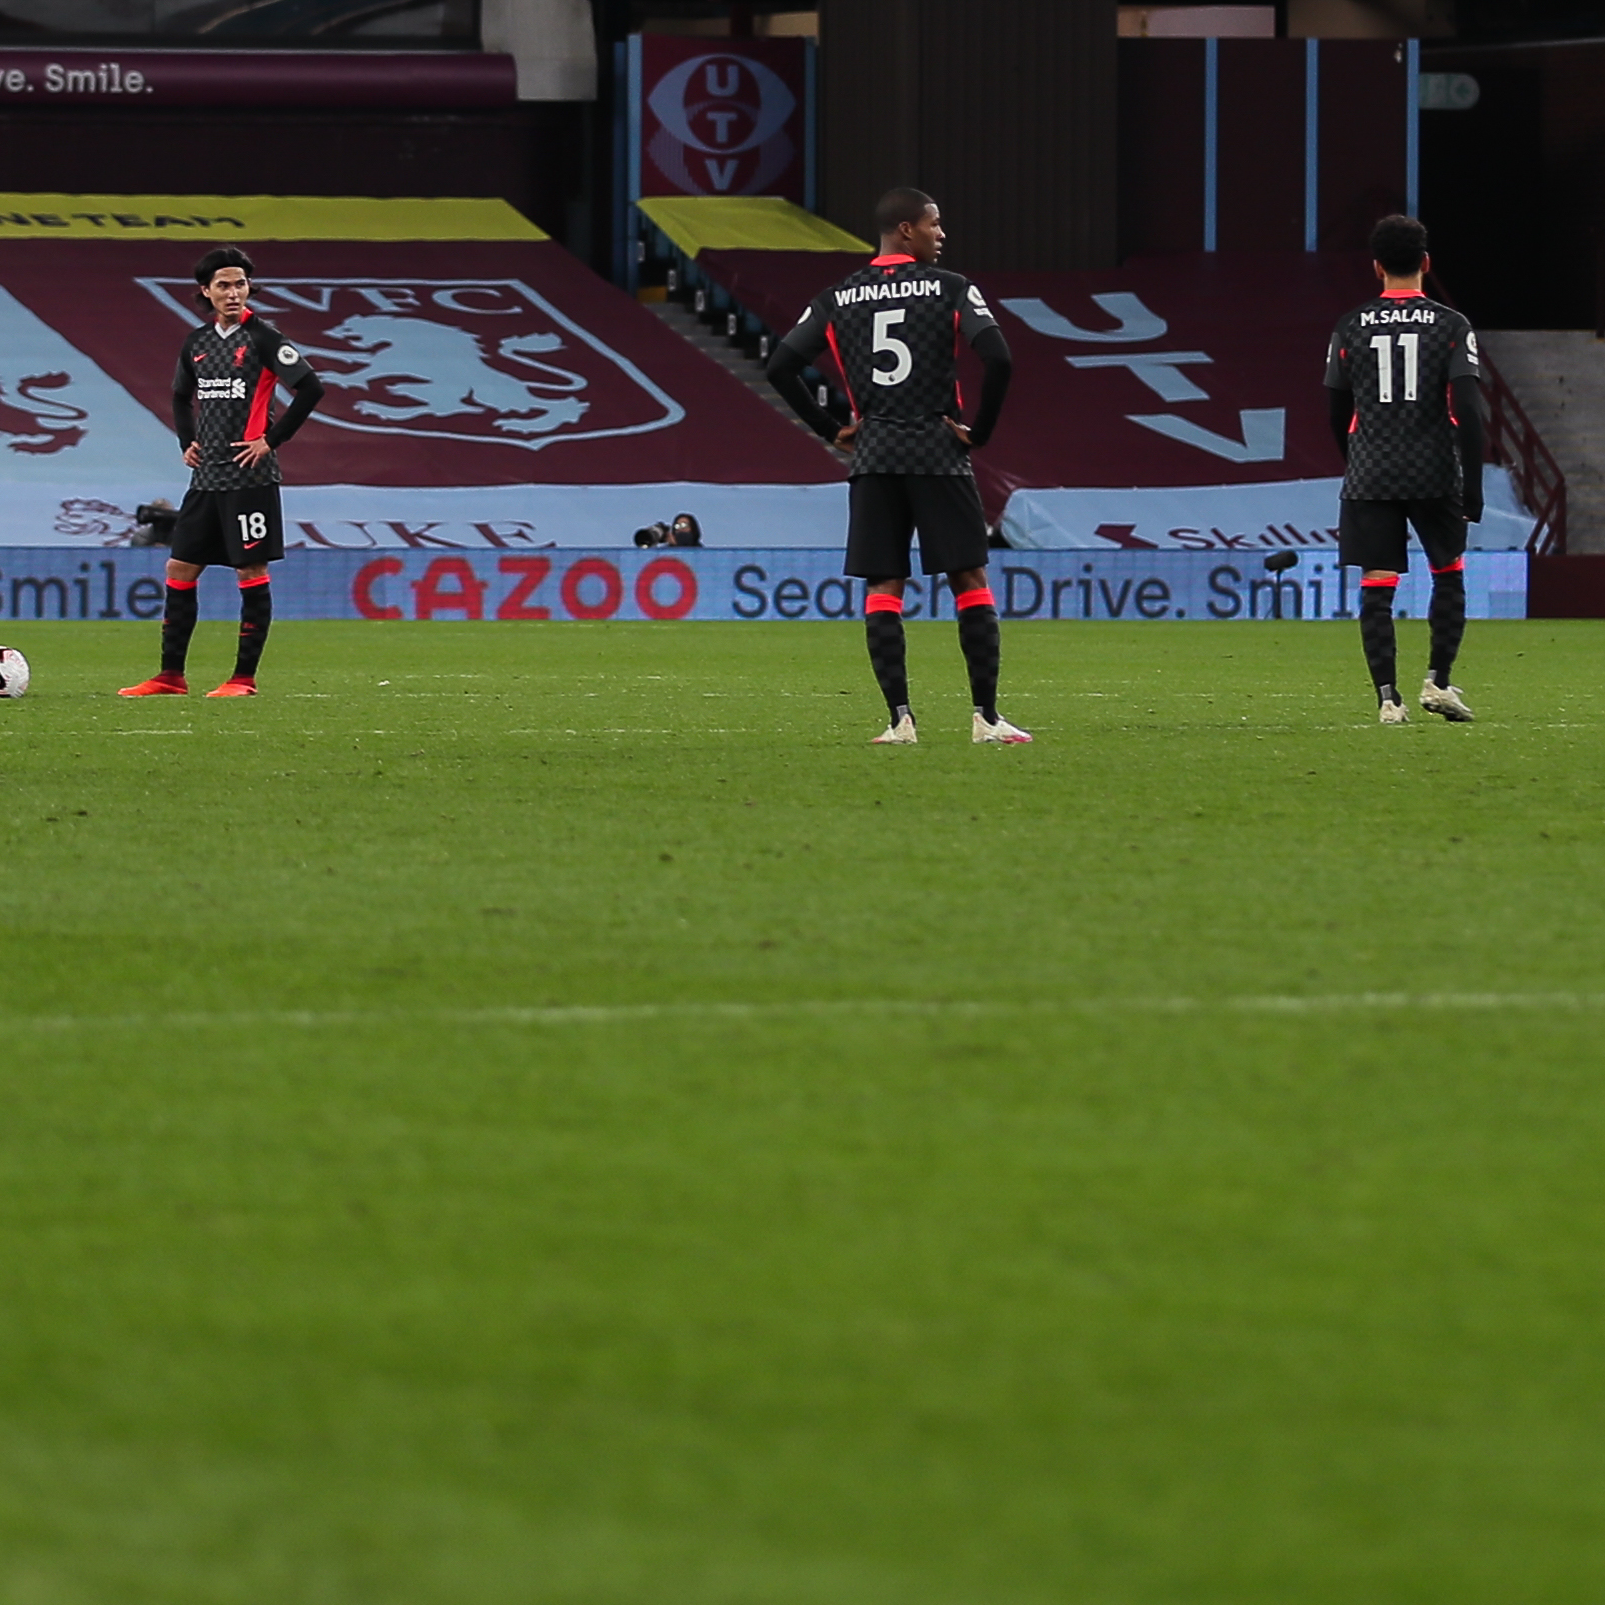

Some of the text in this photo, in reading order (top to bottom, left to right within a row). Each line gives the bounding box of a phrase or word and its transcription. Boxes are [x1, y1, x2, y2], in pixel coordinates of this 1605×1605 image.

[45, 62, 154, 95] Smile.
[71, 213, 246, 229] TEAM
[835, 280, 941, 307] WIJNALDUM
[1361, 308, 1436, 327] M.SALAH
[872, 309, 912, 386] 5
[1370, 333, 1419, 403] 11
[197, 377, 231, 388] Standard
[197, 389, 231, 400] Chartered
[238, 511, 267, 542] 18
[285, 520, 557, 548] UKE
[1168, 523, 1340, 550] Skilli
[352, 557, 698, 621] CAZOO
[1002, 562, 1186, 620] Drive.
[1206, 562, 1407, 620] Smil.
